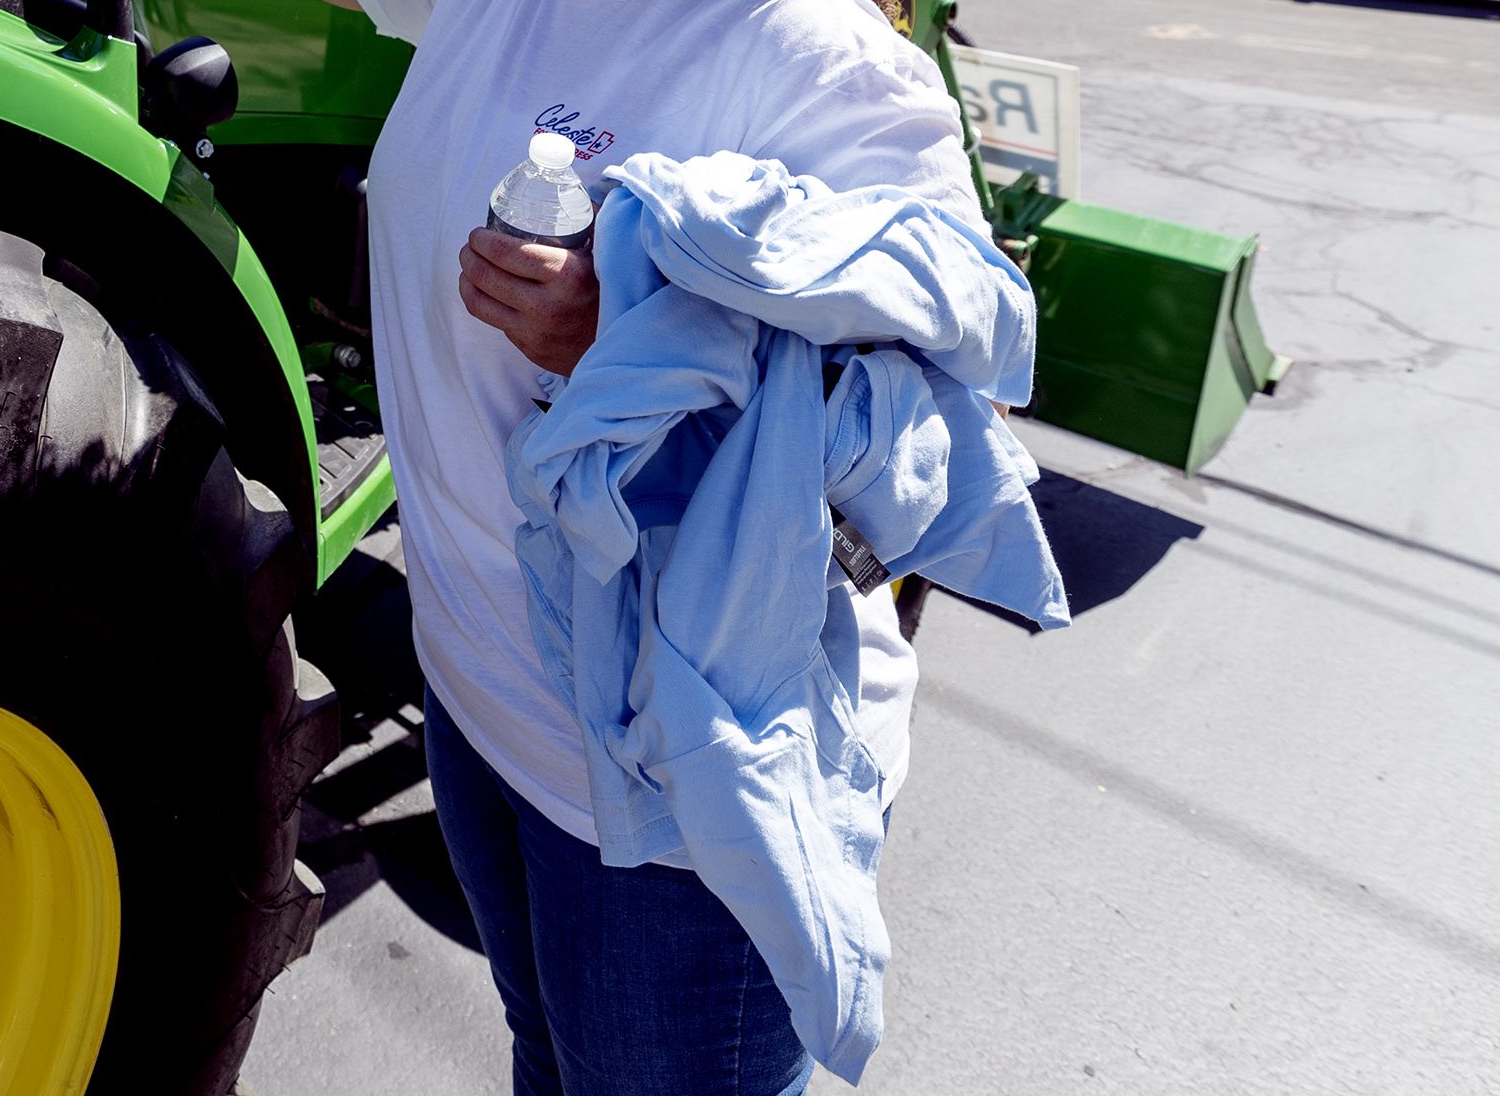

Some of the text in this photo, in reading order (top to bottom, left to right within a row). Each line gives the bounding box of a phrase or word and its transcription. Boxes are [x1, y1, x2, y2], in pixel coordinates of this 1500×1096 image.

[535, 104, 596, 146] Celeste
[575, 147, 594, 161] RESS
[833, 528, 855, 553] GILD
